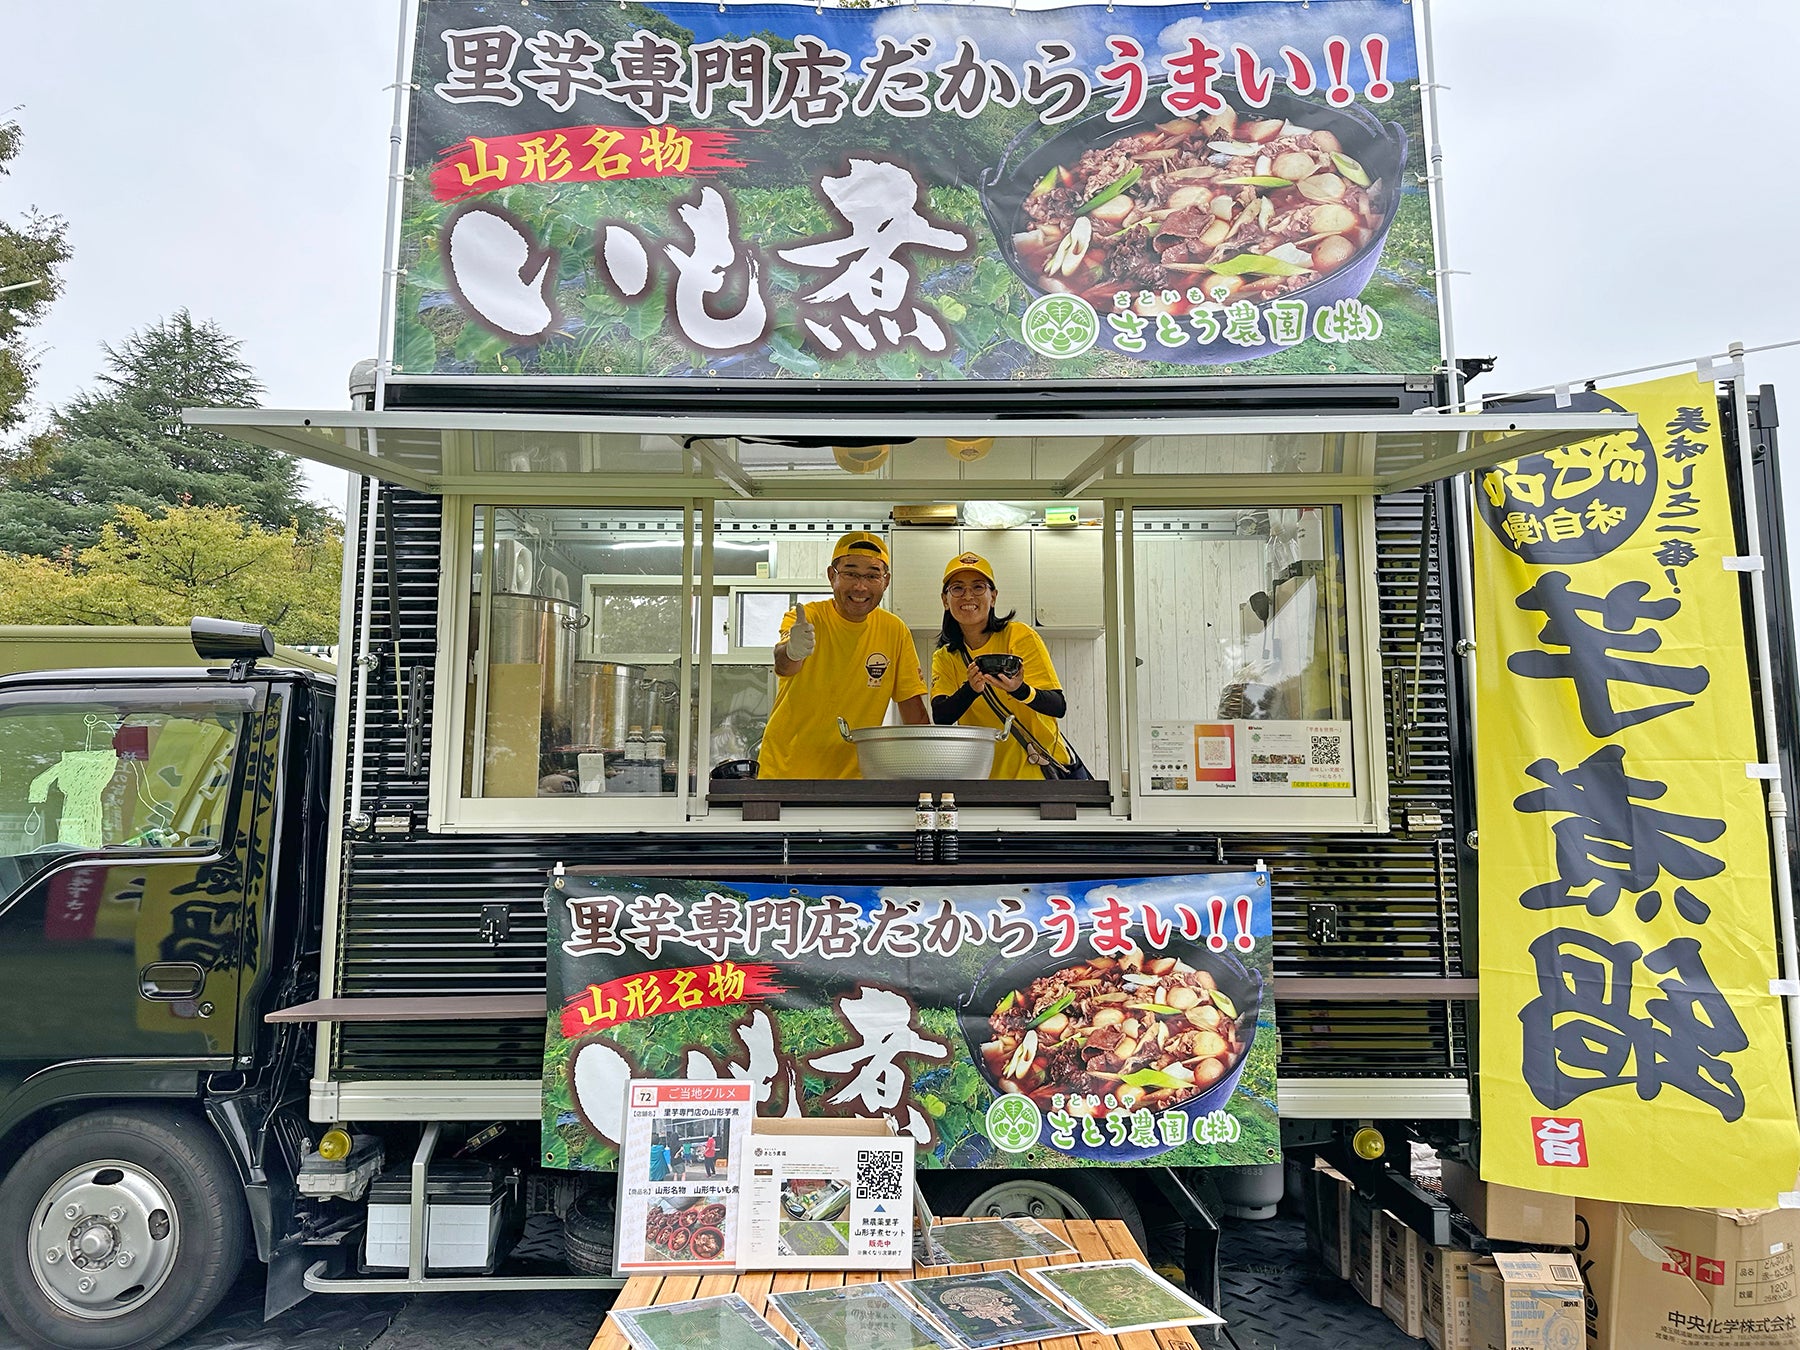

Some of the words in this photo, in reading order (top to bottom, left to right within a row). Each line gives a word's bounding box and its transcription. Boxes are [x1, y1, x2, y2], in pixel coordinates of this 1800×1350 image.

[455, 126, 694, 189] 山形名物
[449, 158, 969, 352] いも煮
[1113, 286, 1231, 307] さといもや
[1106, 298, 1384, 352] さとう農園(株)
[578, 962, 748, 1029] 山形名物
[640, 1092, 652, 1102] 72
[668, 1087, 736, 1100] ご当地グルメ
[1051, 1093, 1137, 1109] さといもや
[663, 1108, 740, 1118] 里芋専門店の山形芋煮
[1048, 1110, 1242, 1150] さとう農園(株)
[655, 1186, 687, 1195] 山形名物
[693, 1185, 740, 1195] 山形牛いも煮
[862, 1217, 900, 1227] 無農薬里芋
[854, 1228, 906, 1237] 山形芋煮セット
[868, 1239, 891, 1248] 販売中
[1739, 1290, 1753, 1299] 数量
[1510, 1301, 1539, 1310] SUNDAY
[1510, 1311, 1546, 1319] RAINBOW
[1667, 1310, 1797, 1334] 中央化学株式会社
[1511, 1327, 1540, 1339] mini
